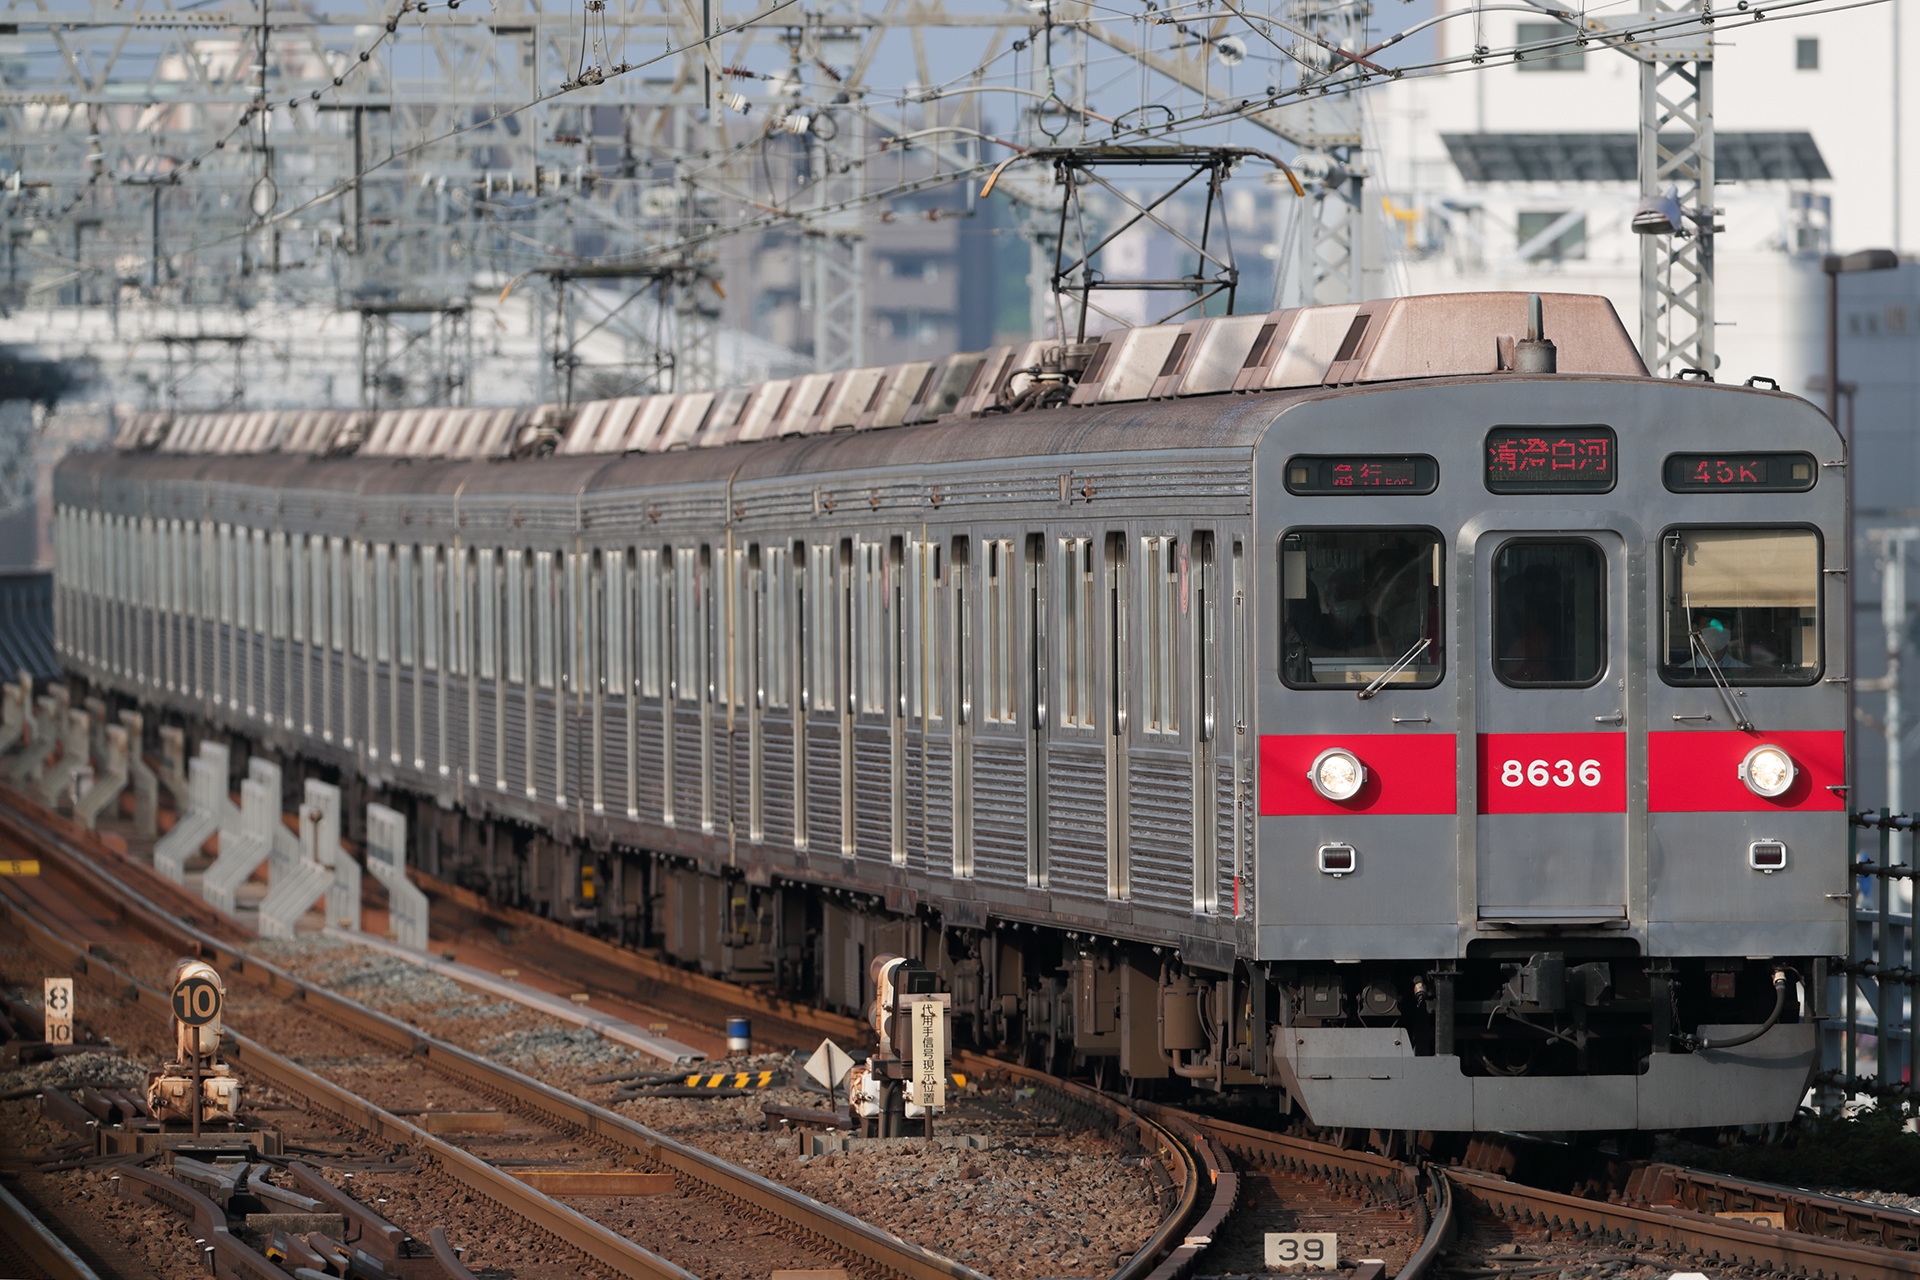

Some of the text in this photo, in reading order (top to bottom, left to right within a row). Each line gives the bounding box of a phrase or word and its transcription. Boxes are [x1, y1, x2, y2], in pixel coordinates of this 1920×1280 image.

[1488, 438, 1609, 471] 清澄白河
[1693, 461, 1757, 483] 45K
[1501, 759, 1602, 788] 8636
[49, 986, 69, 1010] 8
[177, 984, 216, 1018] 10
[49, 1023, 70, 1041] 10
[922, 1003, 936, 1105] 代用手信号現示位置
[1278, 1238, 1324, 1261] 39
